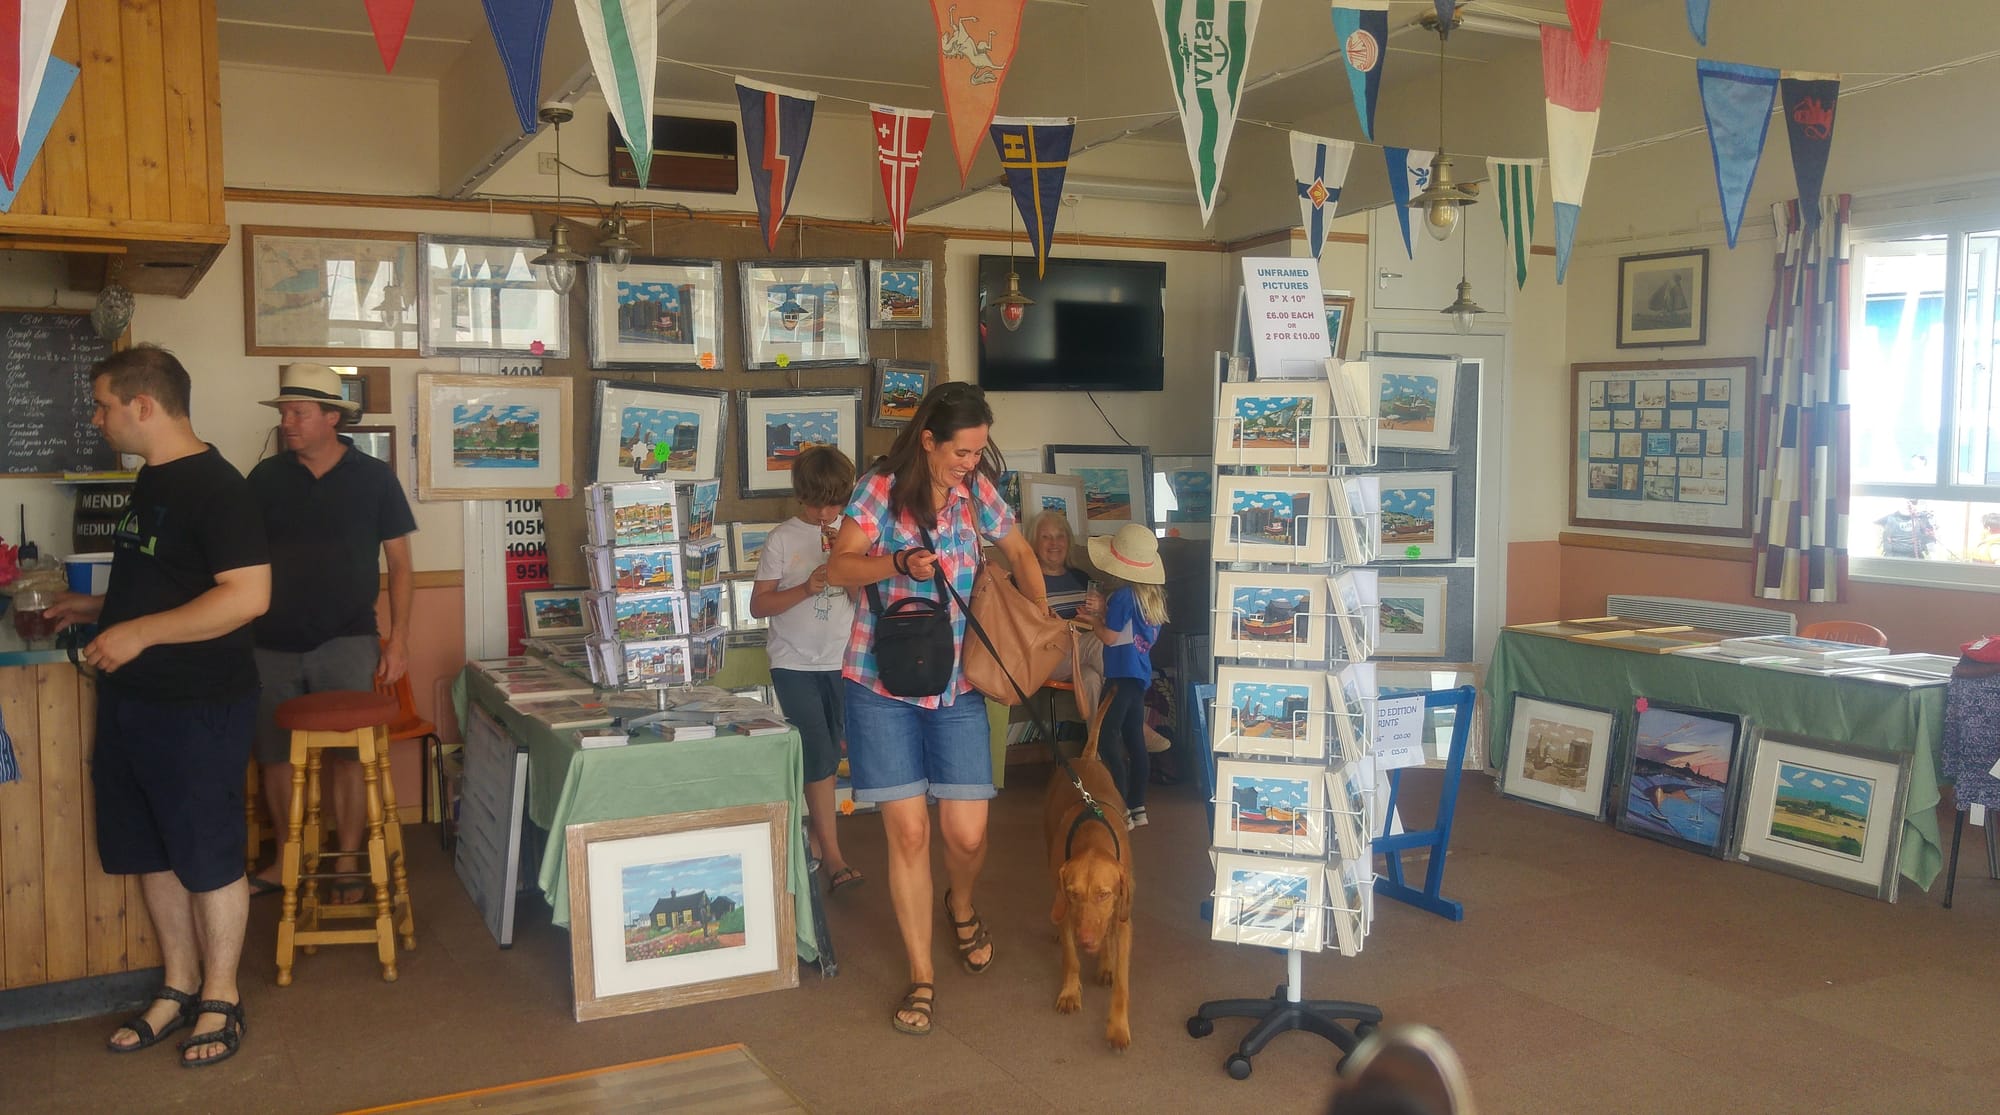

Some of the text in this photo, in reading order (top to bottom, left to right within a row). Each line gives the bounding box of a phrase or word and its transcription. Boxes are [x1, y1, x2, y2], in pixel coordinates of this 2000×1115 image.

[1257, 268, 1309, 277] UNFRAMED
[1262, 282, 1309, 290] PICTURES
[505, 520, 546, 535] 105K
[506, 542, 547, 557] 100K
[516, 564, 549, 579] 95K
[1387, 704, 1417, 716] EDITION
